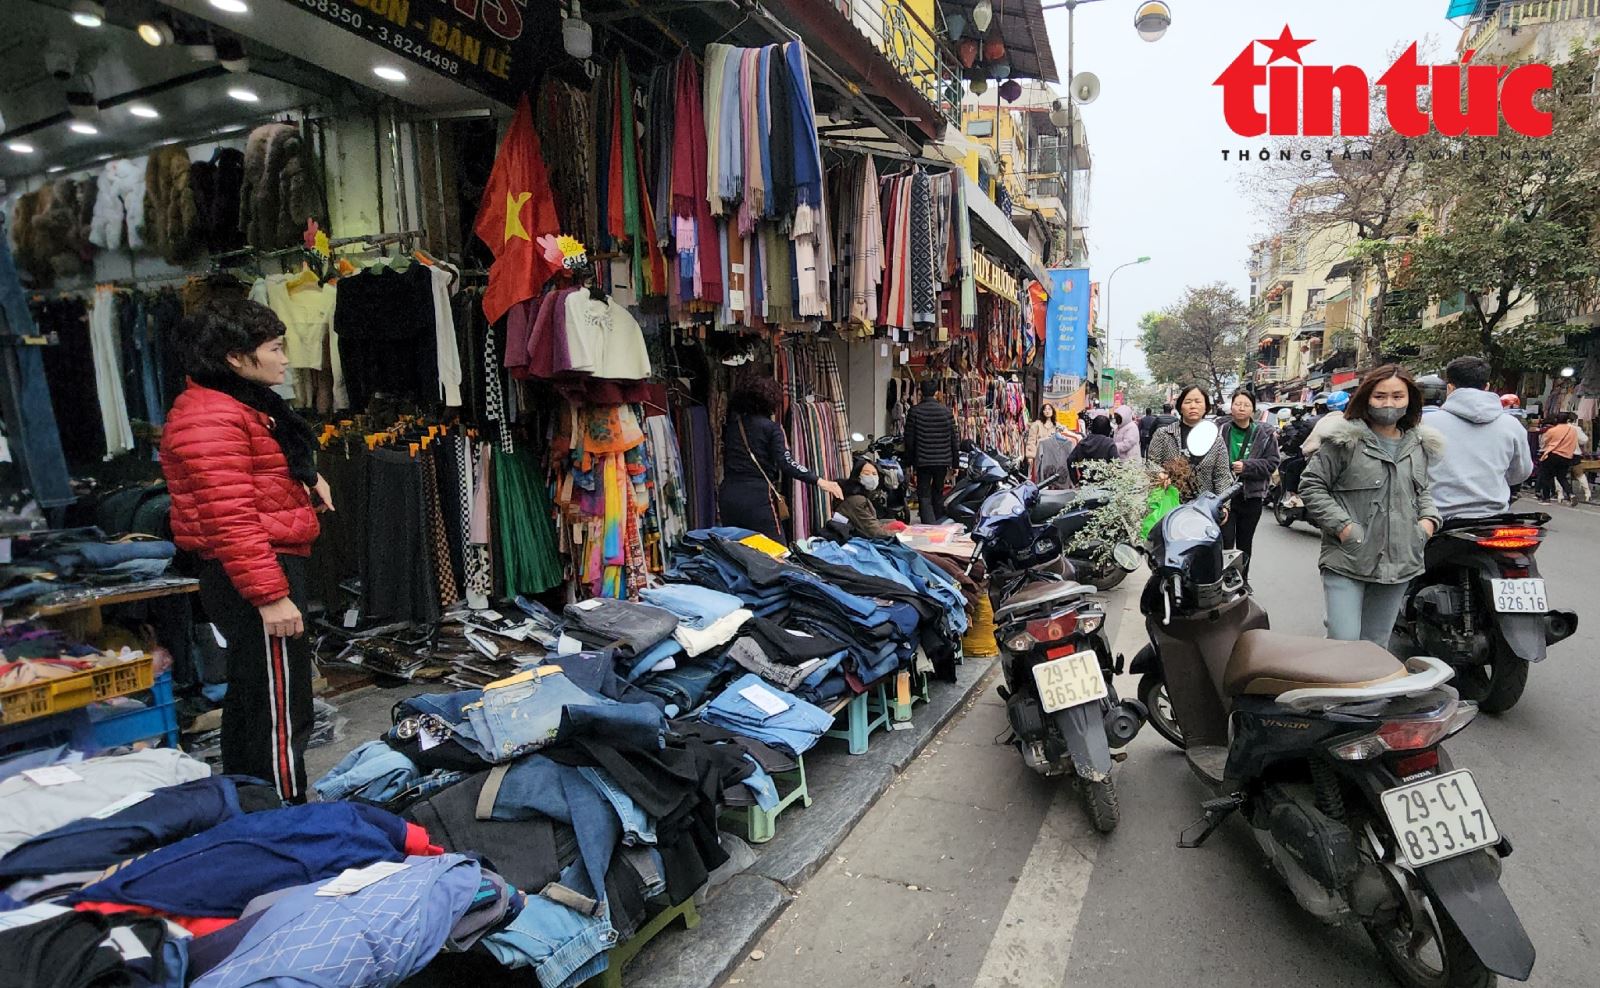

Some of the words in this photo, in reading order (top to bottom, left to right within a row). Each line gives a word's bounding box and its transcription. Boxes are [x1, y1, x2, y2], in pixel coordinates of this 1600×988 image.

[378, 26, 459, 75] 3.8244498
[563, 253, 586, 268] SALE
[1500, 581, 1538, 595] 29-C1
[1498, 596, 1545, 611] 926.16
[1043, 656, 1089, 686] 29-F1
[1046, 676, 1102, 708] 365.42
[1260, 718, 1312, 730] VISION
[1402, 770, 1433, 783] HONDA
[1397, 778, 1468, 824] 29-C1
[1404, 808, 1488, 860] 833.47
